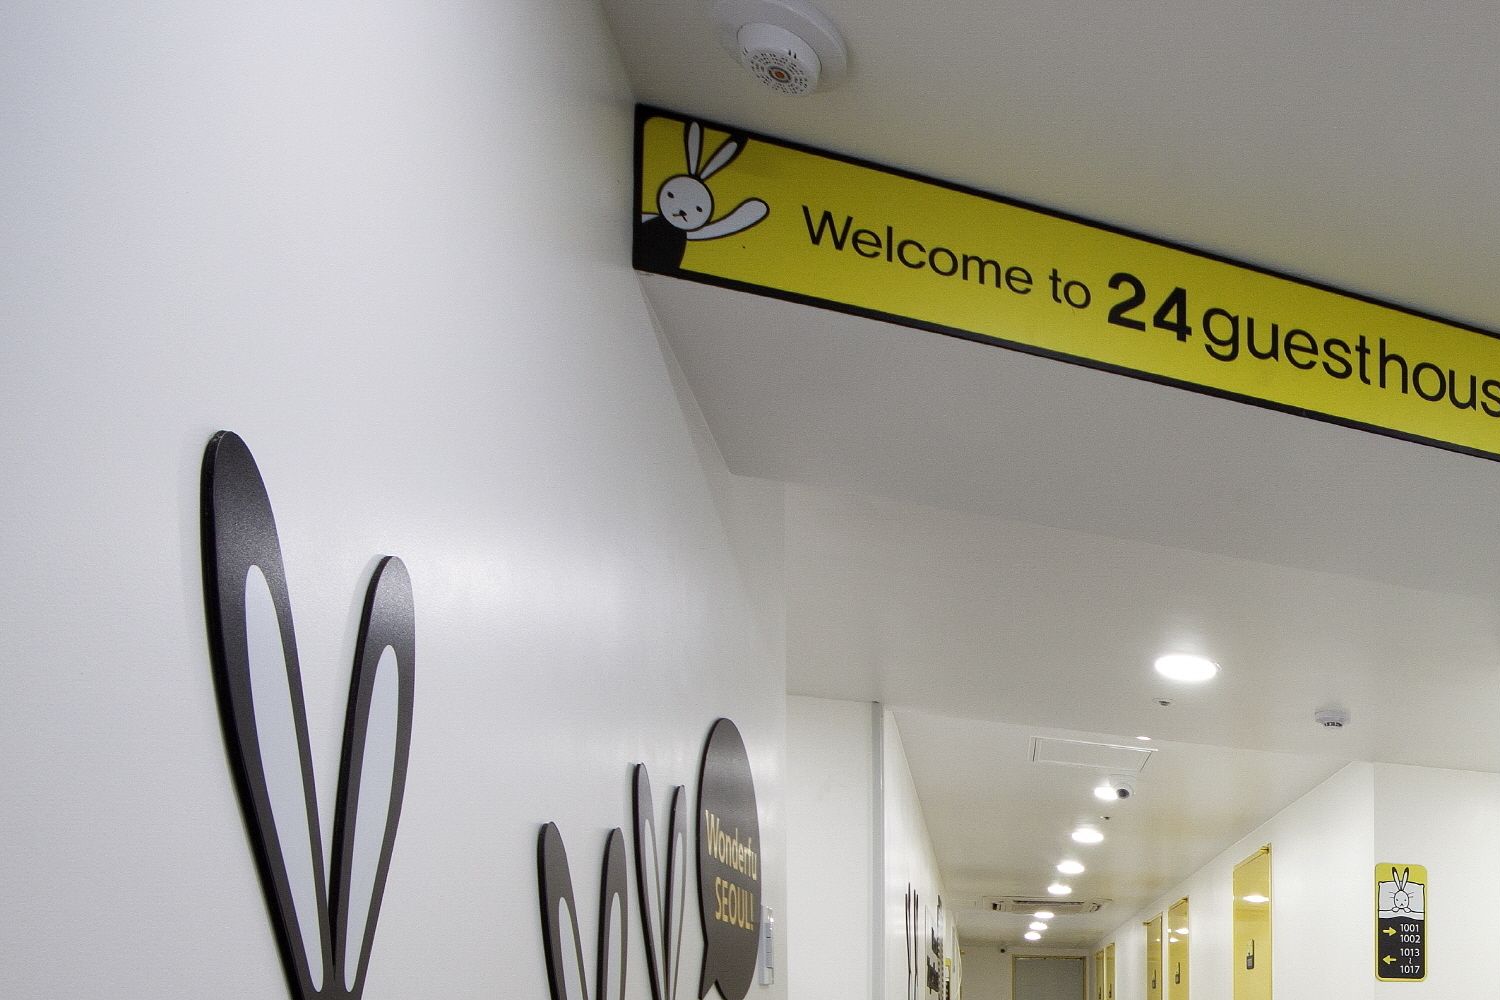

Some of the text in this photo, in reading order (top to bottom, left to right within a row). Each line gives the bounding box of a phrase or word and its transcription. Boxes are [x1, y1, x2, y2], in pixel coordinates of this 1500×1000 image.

[801, 204, 1033, 295] Welcome
[1049, 267, 1092, 310] to
[1399, 923, 1420, 933] 1001
[1399, 934, 1421, 944] 1002
[1399, 948, 1421, 957] 1013
[1399, 965, 1421, 974] 1017
